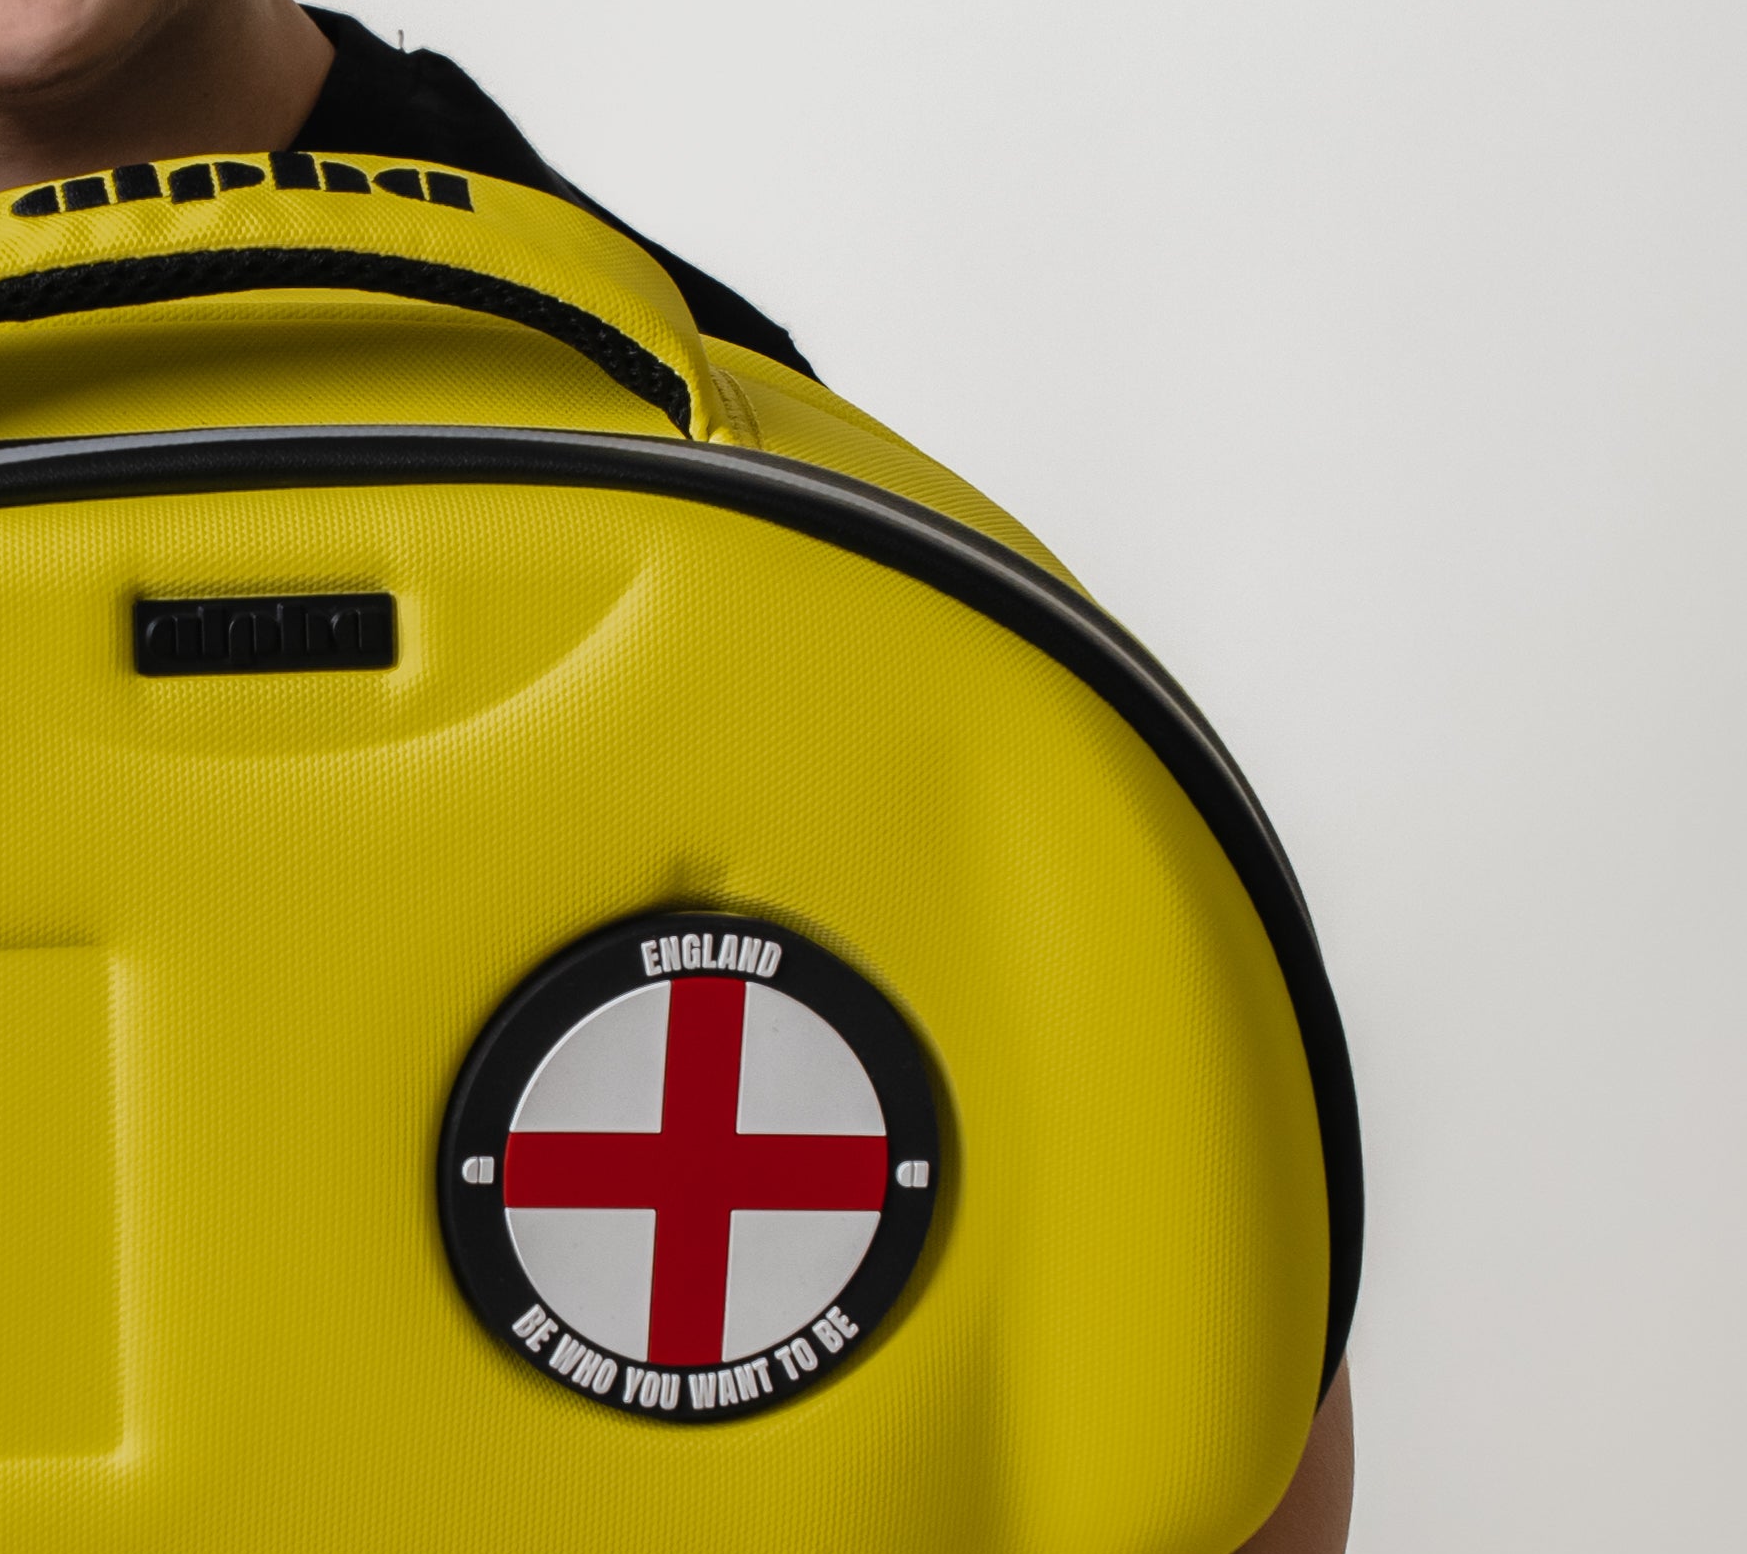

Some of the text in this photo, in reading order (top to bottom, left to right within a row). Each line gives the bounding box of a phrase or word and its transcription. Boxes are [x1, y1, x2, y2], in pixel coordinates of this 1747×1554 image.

[640, 933, 783, 979] ENGLAND
[511, 1303, 860, 1411] BE WHO YOU WANT TO BE
